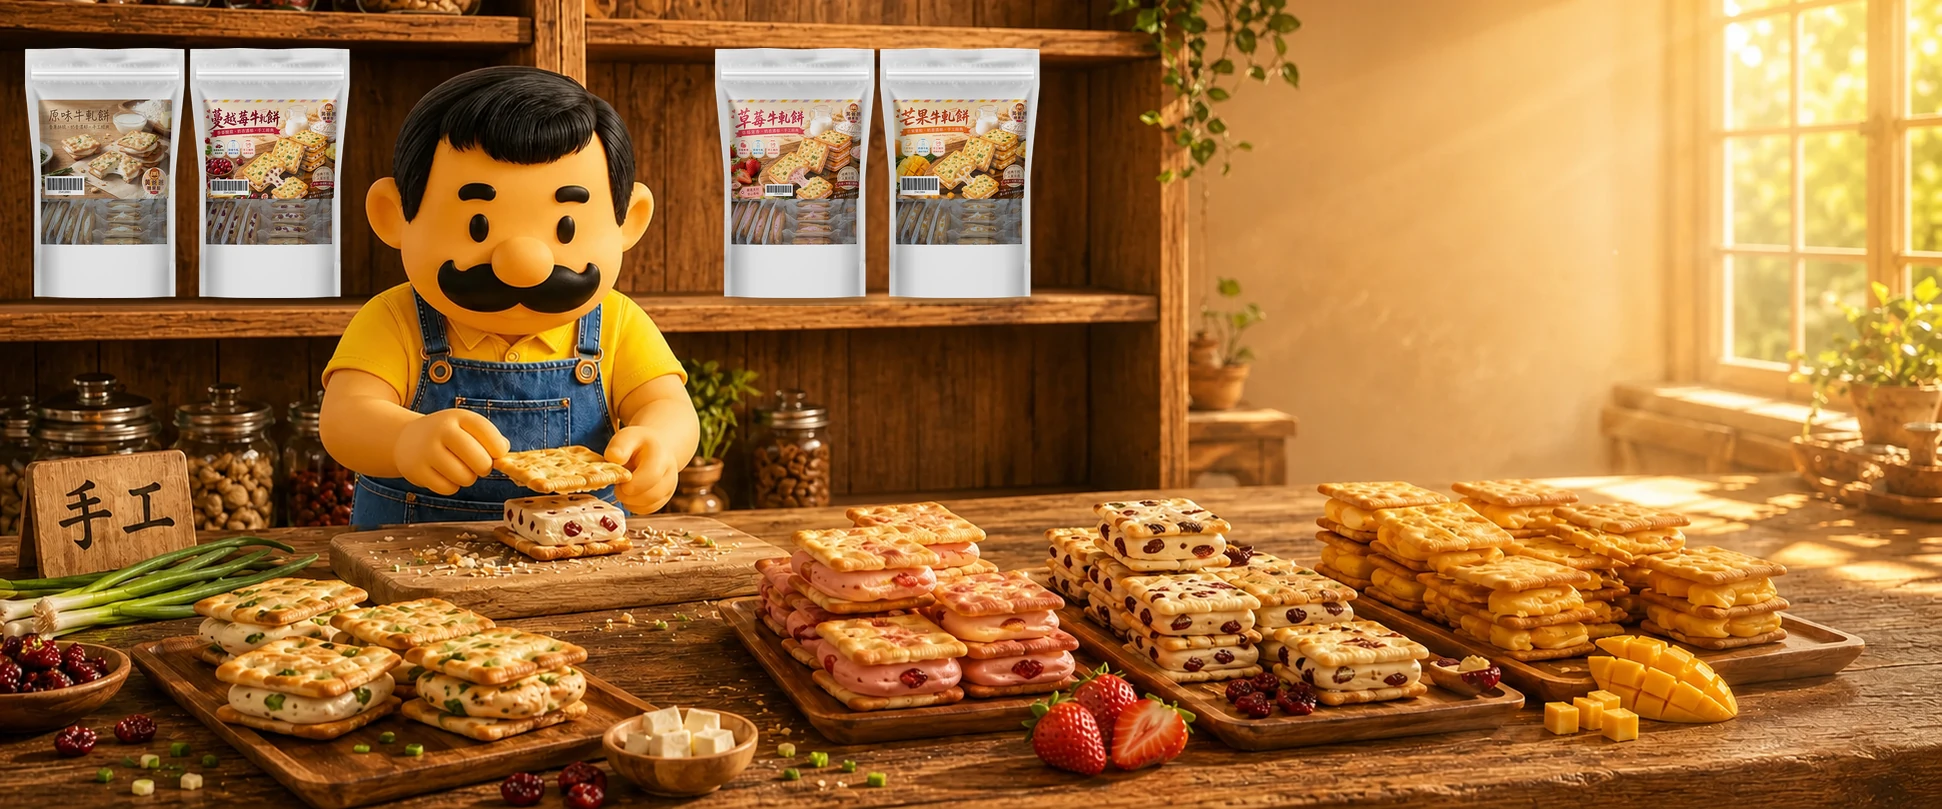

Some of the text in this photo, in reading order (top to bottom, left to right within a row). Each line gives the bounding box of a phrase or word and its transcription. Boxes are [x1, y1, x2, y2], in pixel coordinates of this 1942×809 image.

[49, 109, 110, 123] 原味牛軋餅
[208, 108, 280, 131] 蔓越莓牛軋餅
[735, 107, 804, 129] 草莓牛軋餅
[899, 107, 969, 126] 芒果牛軋餅
[58, 479, 175, 551] 手工
